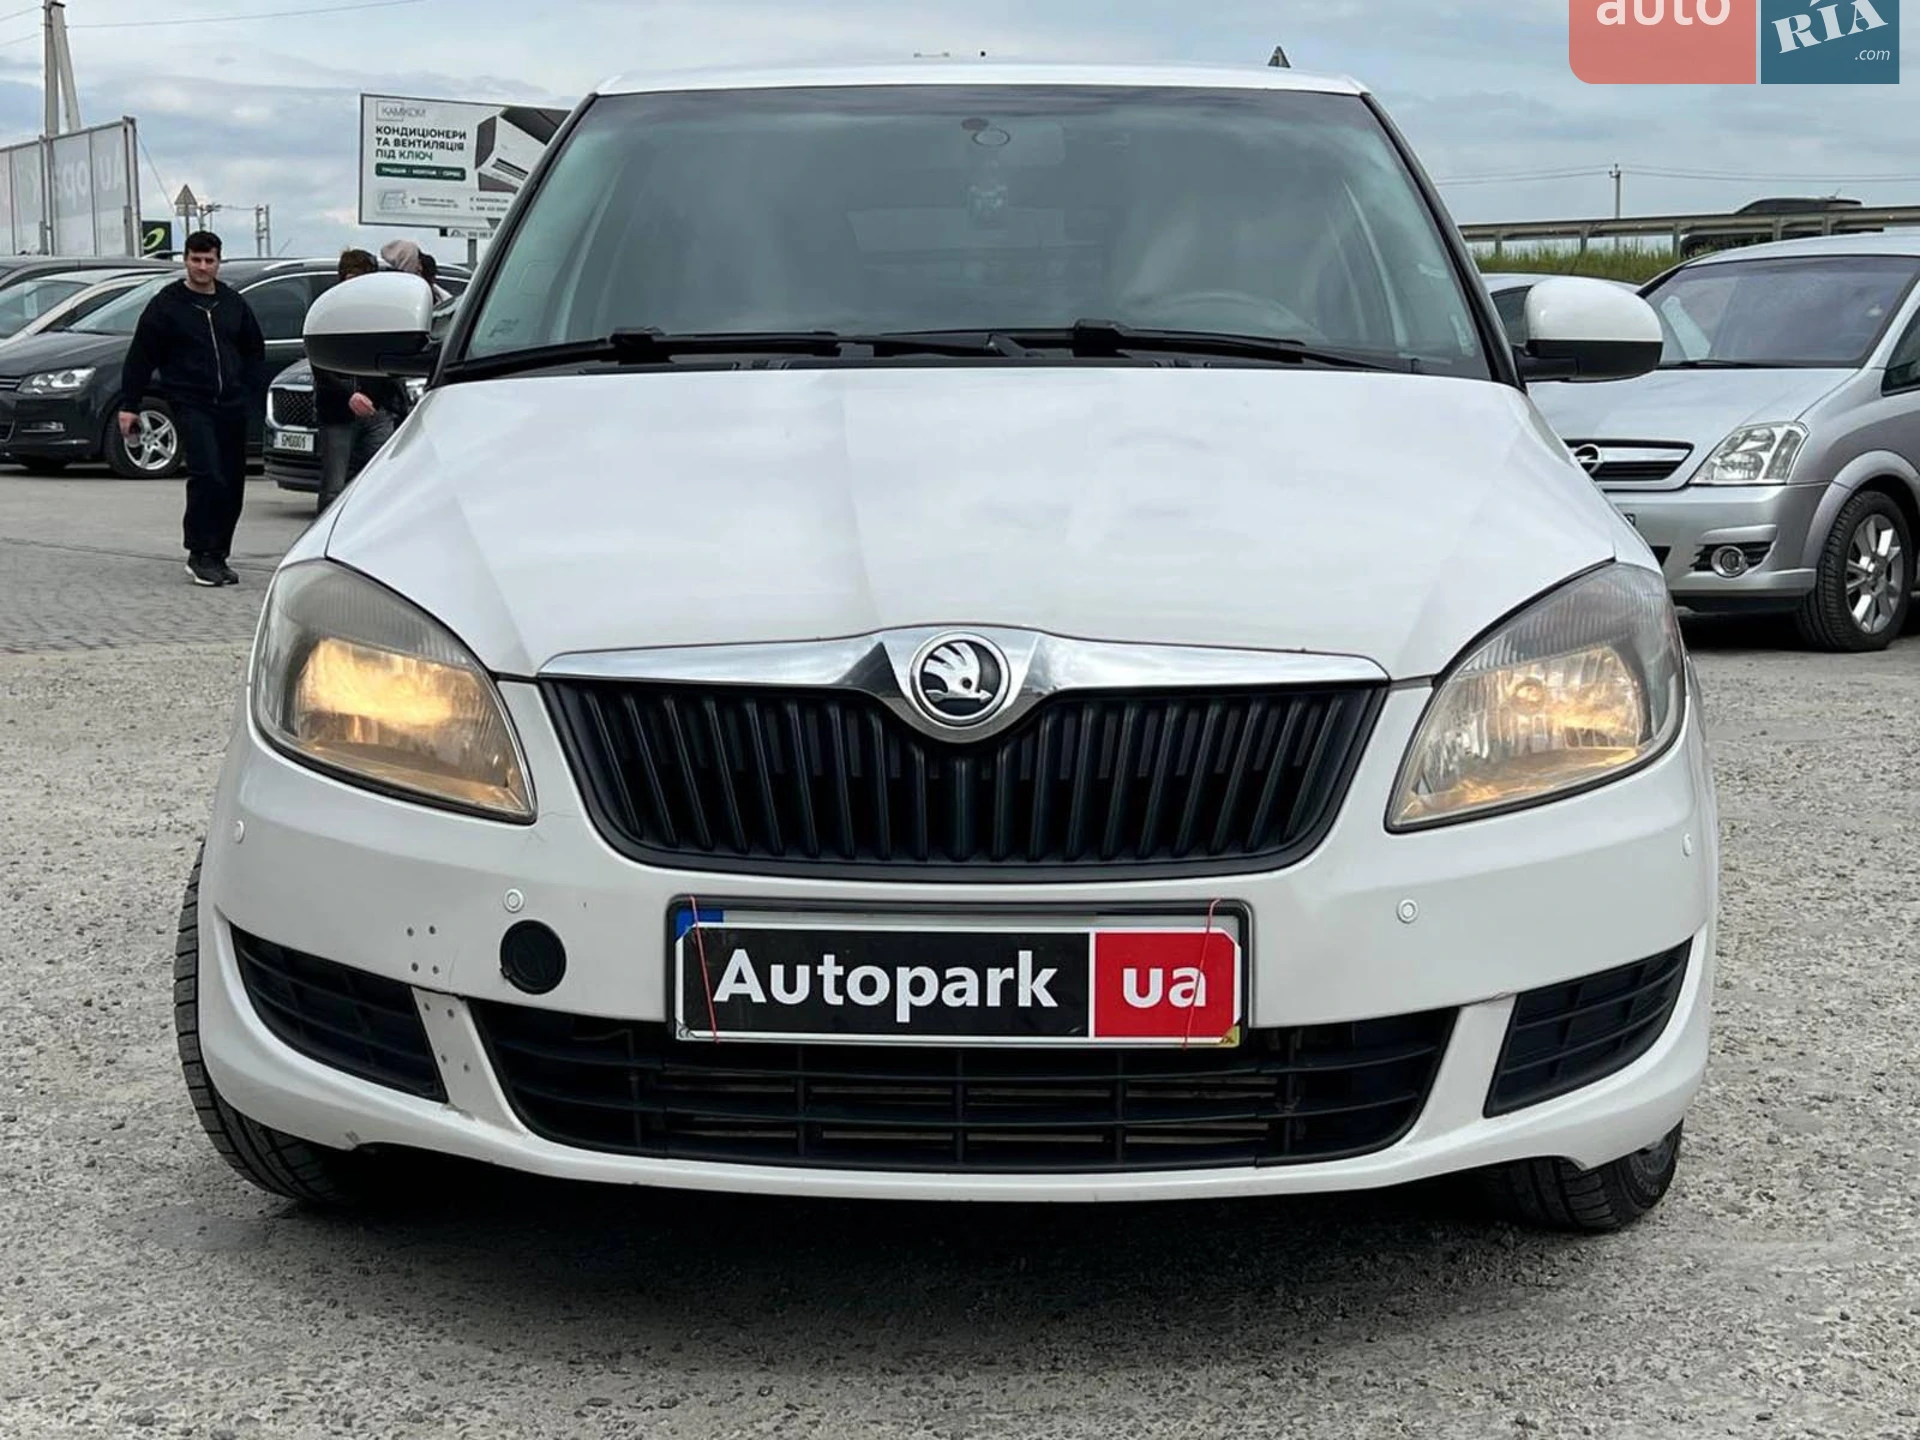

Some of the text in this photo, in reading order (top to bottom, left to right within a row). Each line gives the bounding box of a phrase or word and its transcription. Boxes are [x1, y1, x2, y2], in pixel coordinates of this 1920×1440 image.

[375, 126, 467, 140] КОНДИЦІОНЕРИ
[375, 137, 465, 152] ТА ВЕНТИЛЯЦІЯ
[375, 149, 433, 161] ПІД КЛЮЧ
[713, 948, 1206, 1023] Autopark ua
